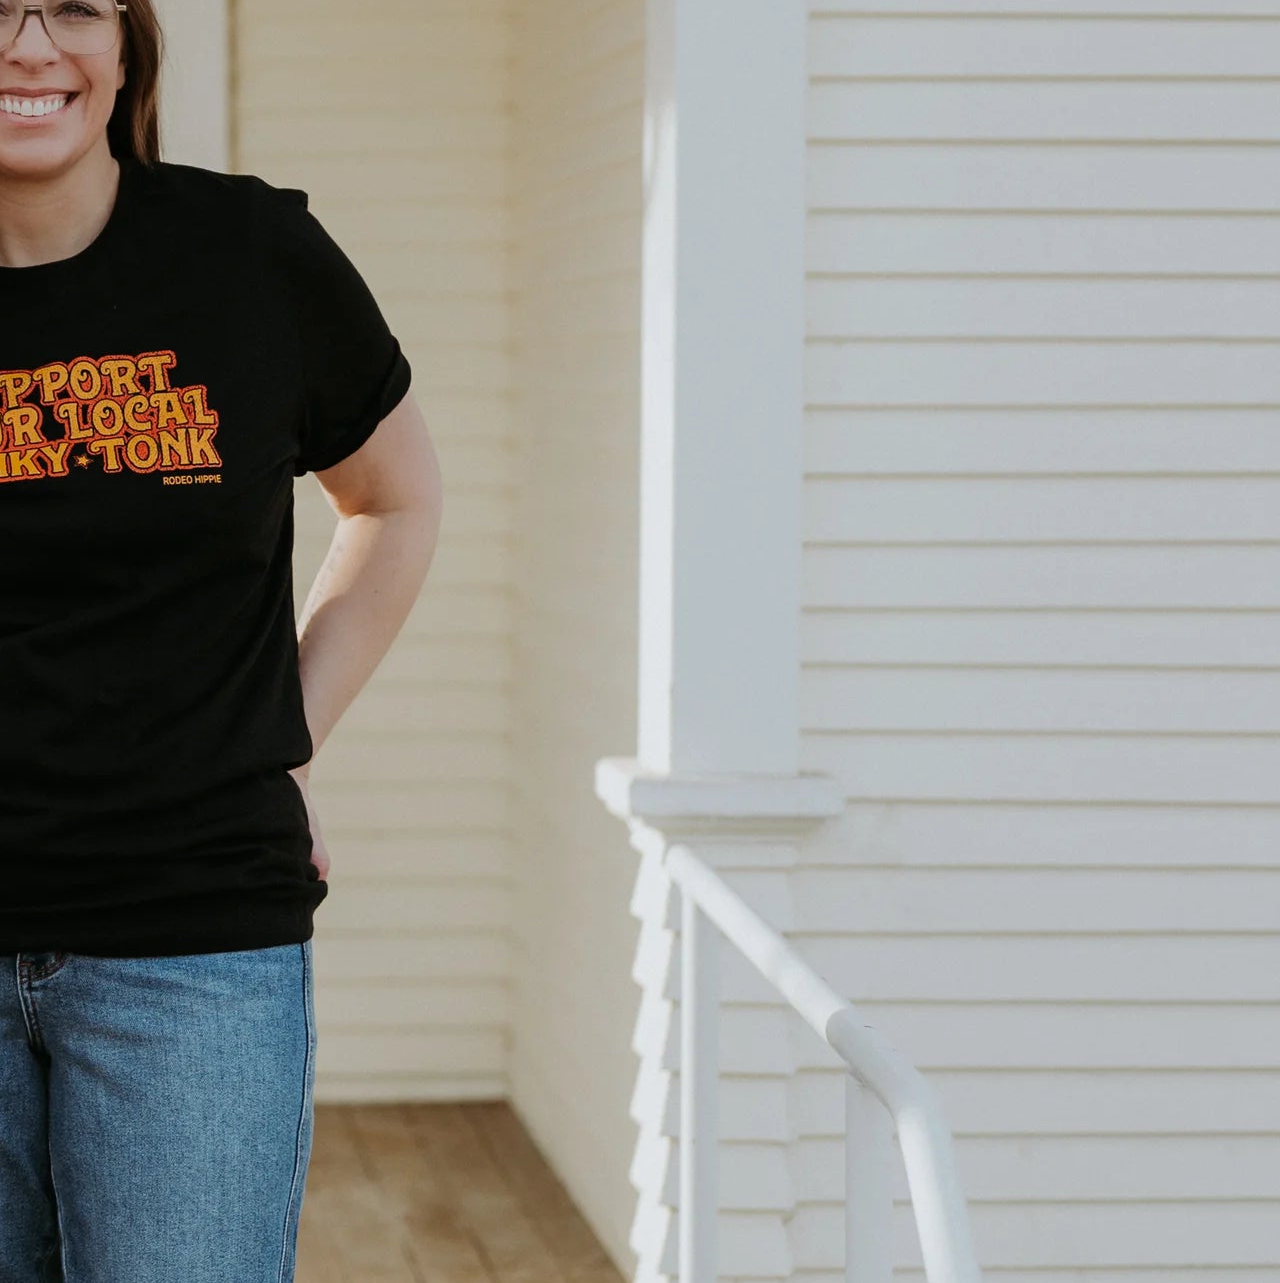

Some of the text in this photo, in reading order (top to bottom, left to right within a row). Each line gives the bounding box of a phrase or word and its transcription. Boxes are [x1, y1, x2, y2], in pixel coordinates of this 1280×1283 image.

[55, 385, 218, 440] LOCAL
[88, 426, 222, 473] TONK
[162, 474, 222, 486] RODEO HIPPIE
